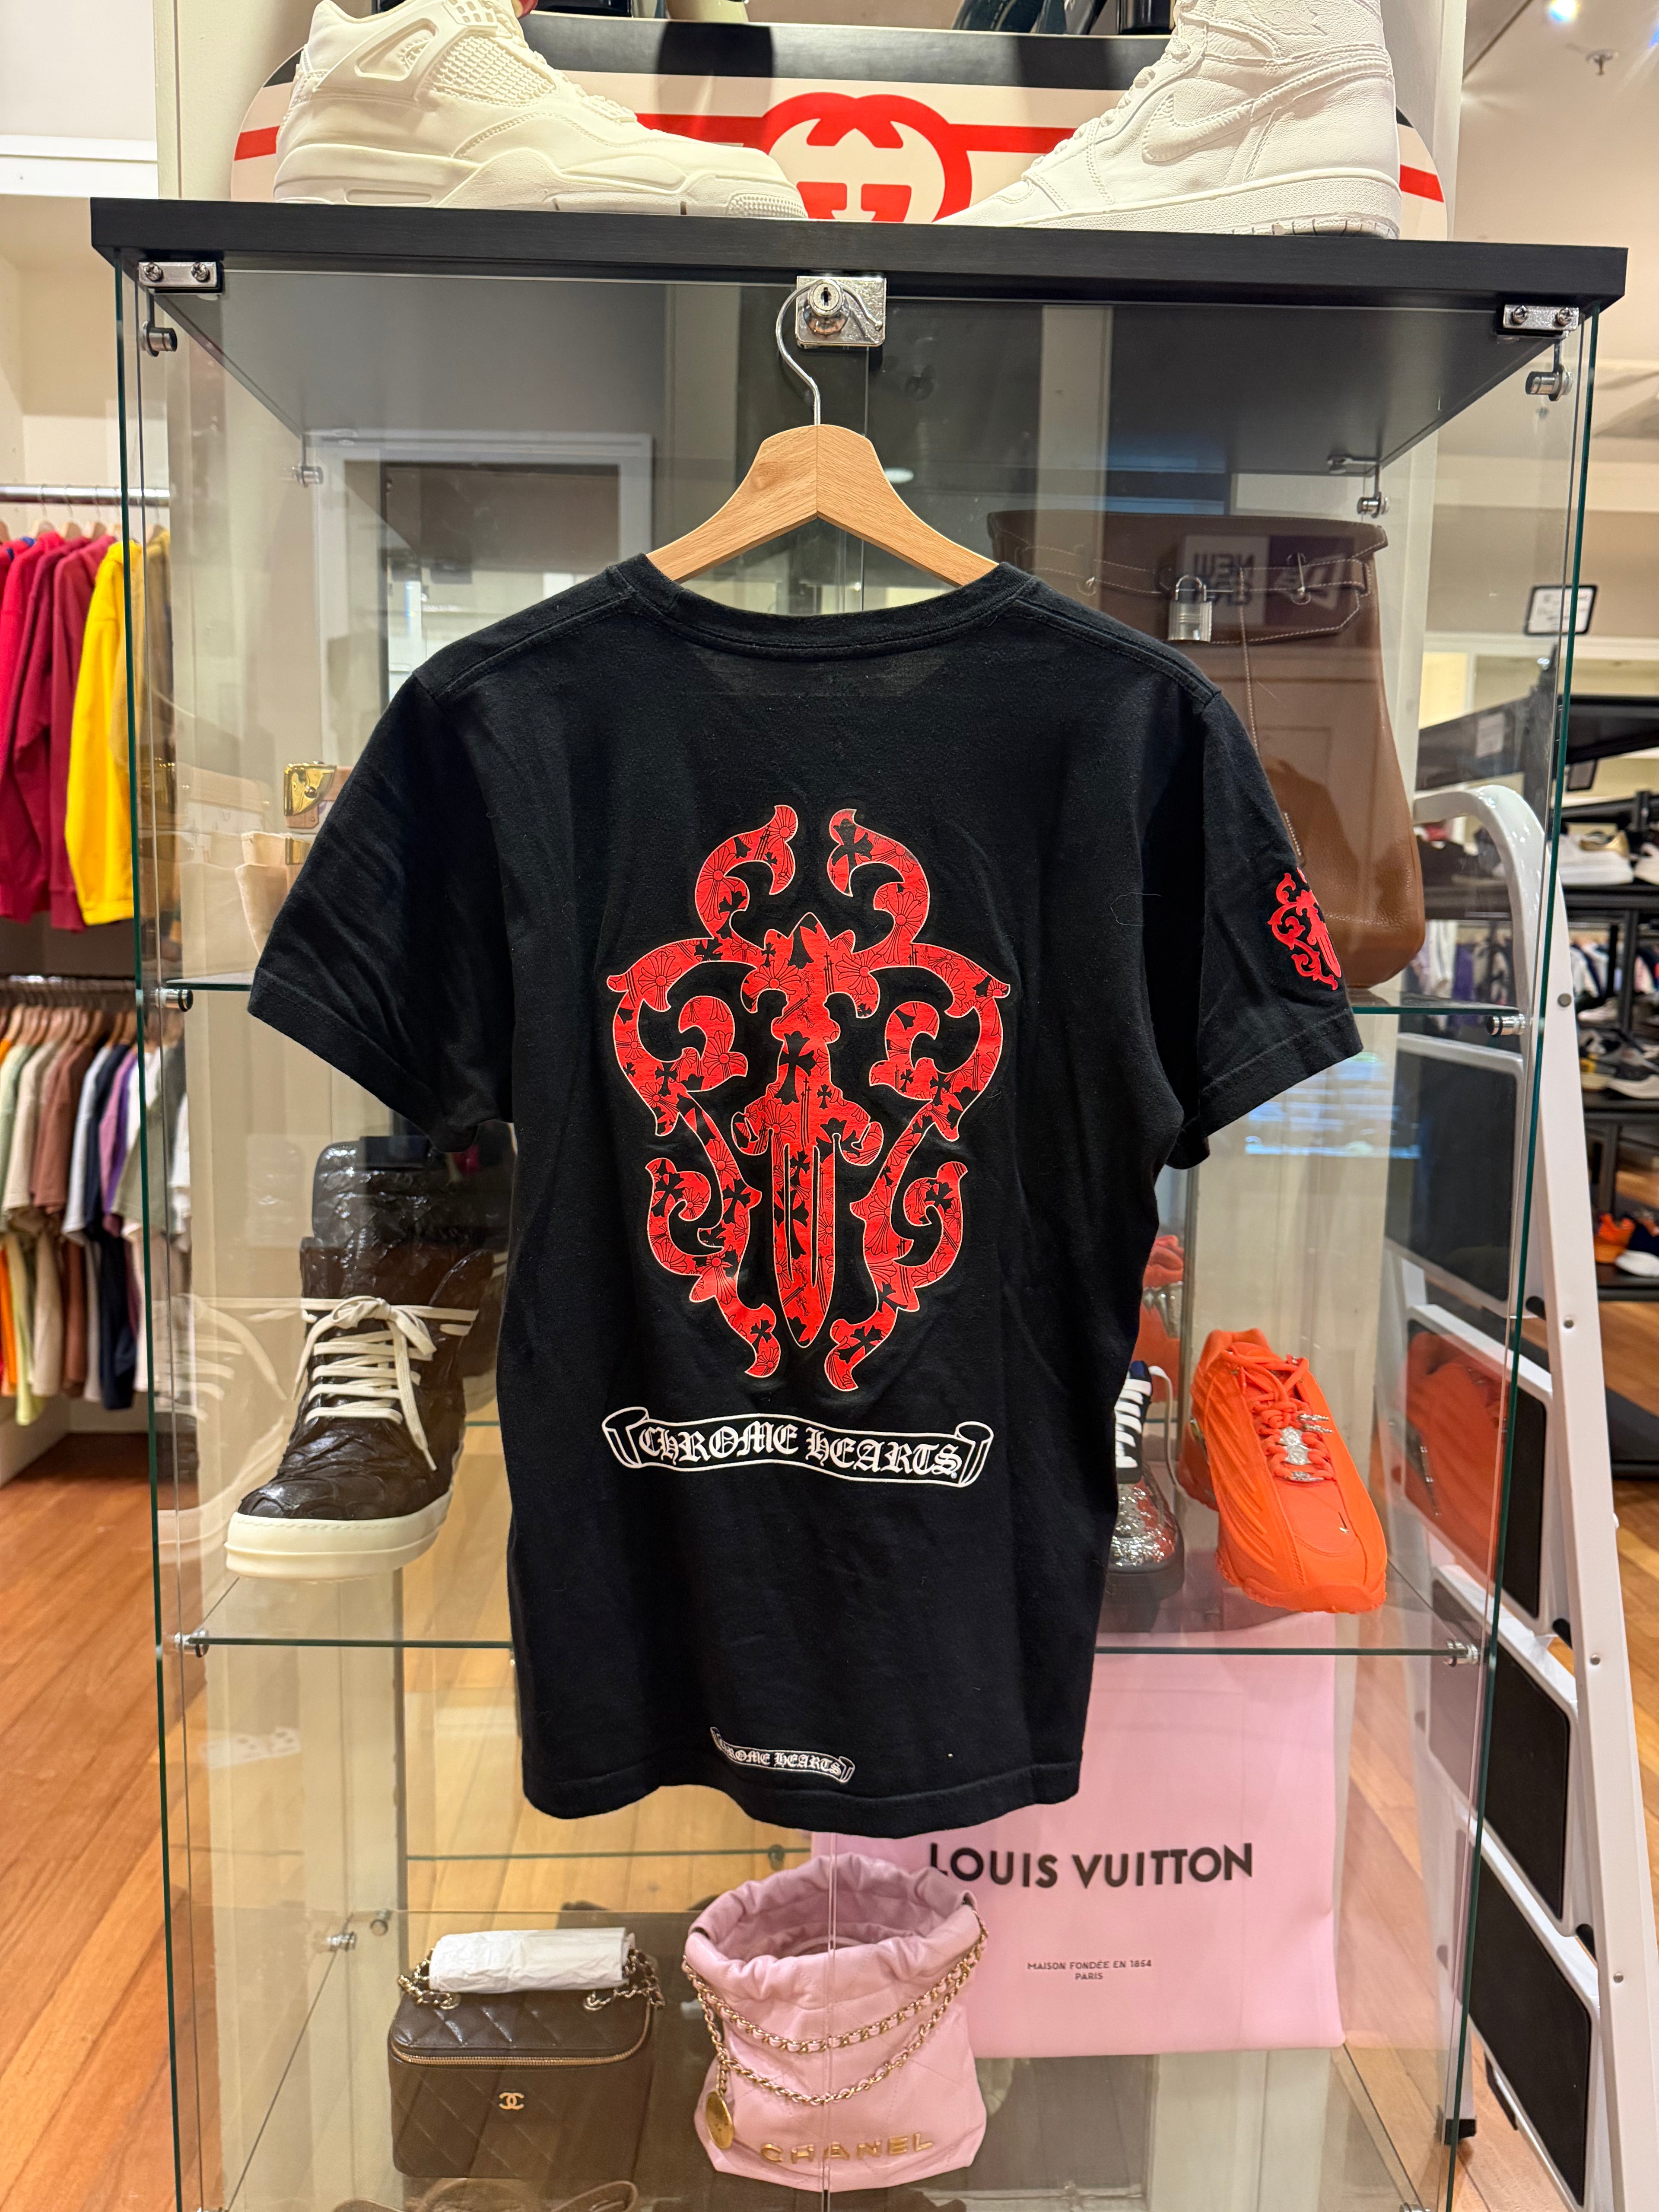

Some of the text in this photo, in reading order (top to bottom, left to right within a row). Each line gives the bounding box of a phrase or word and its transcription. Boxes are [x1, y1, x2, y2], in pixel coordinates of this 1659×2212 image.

[639, 1421, 963, 1475] CHROME HEARTS
[774, 1752, 842, 1775] HEARTS
[930, 1842, 1252, 1888] LOUIS VUITTON
[1027, 1962, 1066, 1970] MAISON
[1075, 1972, 1103, 1980] PARIS
[760, 2132, 933, 2164] CHANEL
